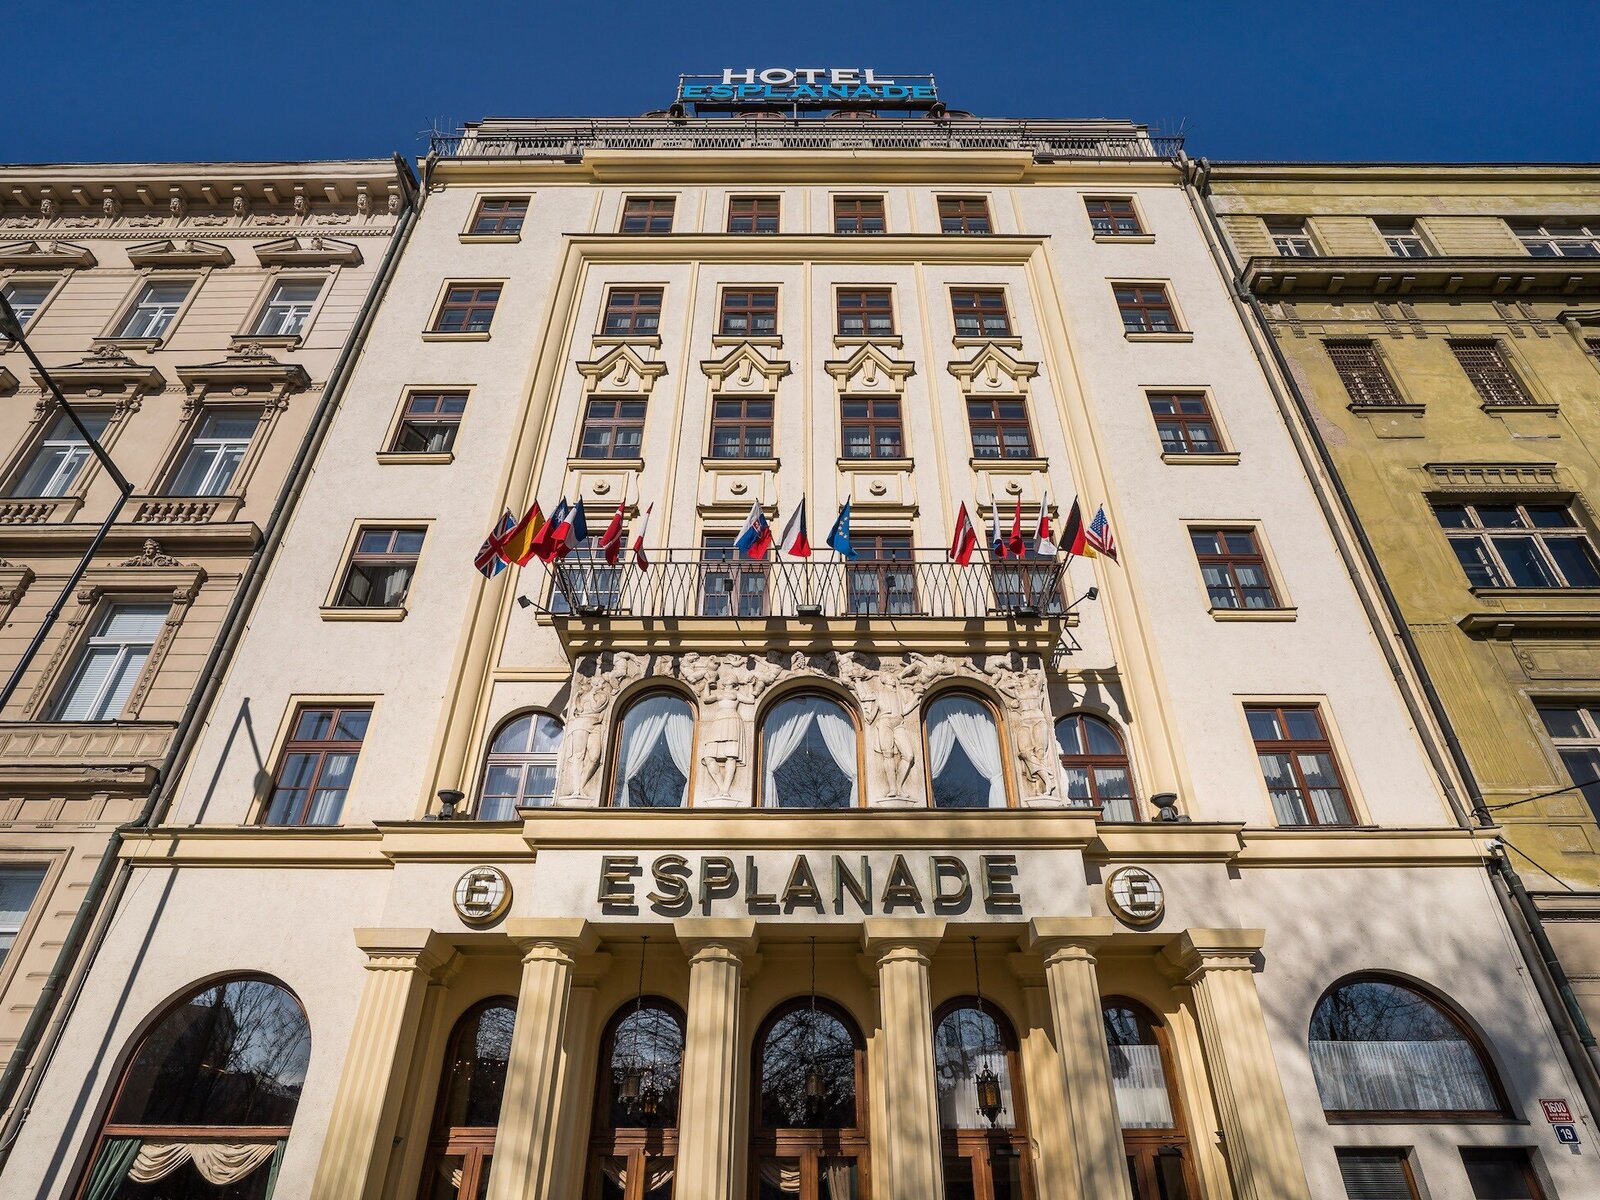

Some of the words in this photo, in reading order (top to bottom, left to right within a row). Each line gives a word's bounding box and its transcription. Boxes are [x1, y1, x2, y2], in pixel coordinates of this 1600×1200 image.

[721, 68, 894, 85] HOTEL
[683, 84, 936, 100] ESPLANADE
[597, 854, 1020, 904] ESPLANADE
[464, 874, 496, 907] E
[1125, 875, 1156, 911] E
[1544, 1102, 1567, 1113] 1600
[1560, 1128, 1573, 1139] 19
